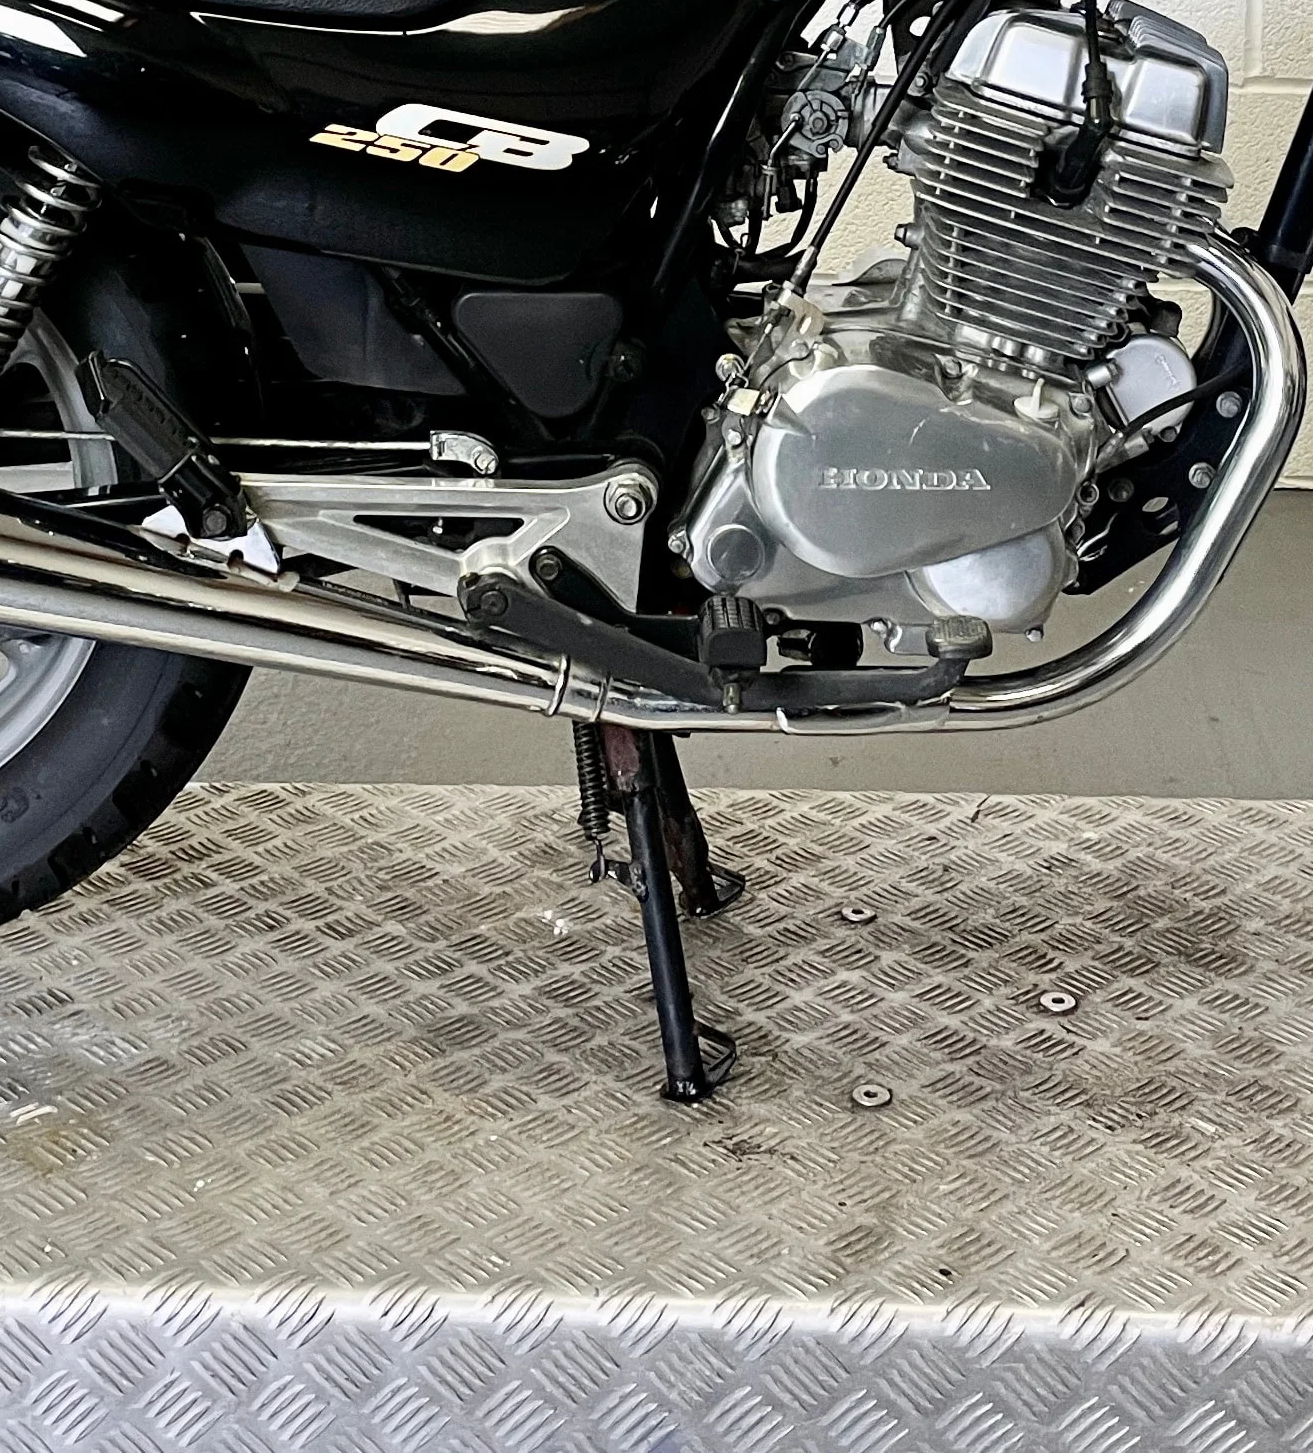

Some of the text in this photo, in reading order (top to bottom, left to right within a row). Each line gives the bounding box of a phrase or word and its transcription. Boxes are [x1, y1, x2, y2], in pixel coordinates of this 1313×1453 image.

[308, 123, 480, 173] 250
[375, 102, 590, 171] CB
[817, 467, 991, 491] HONDA
